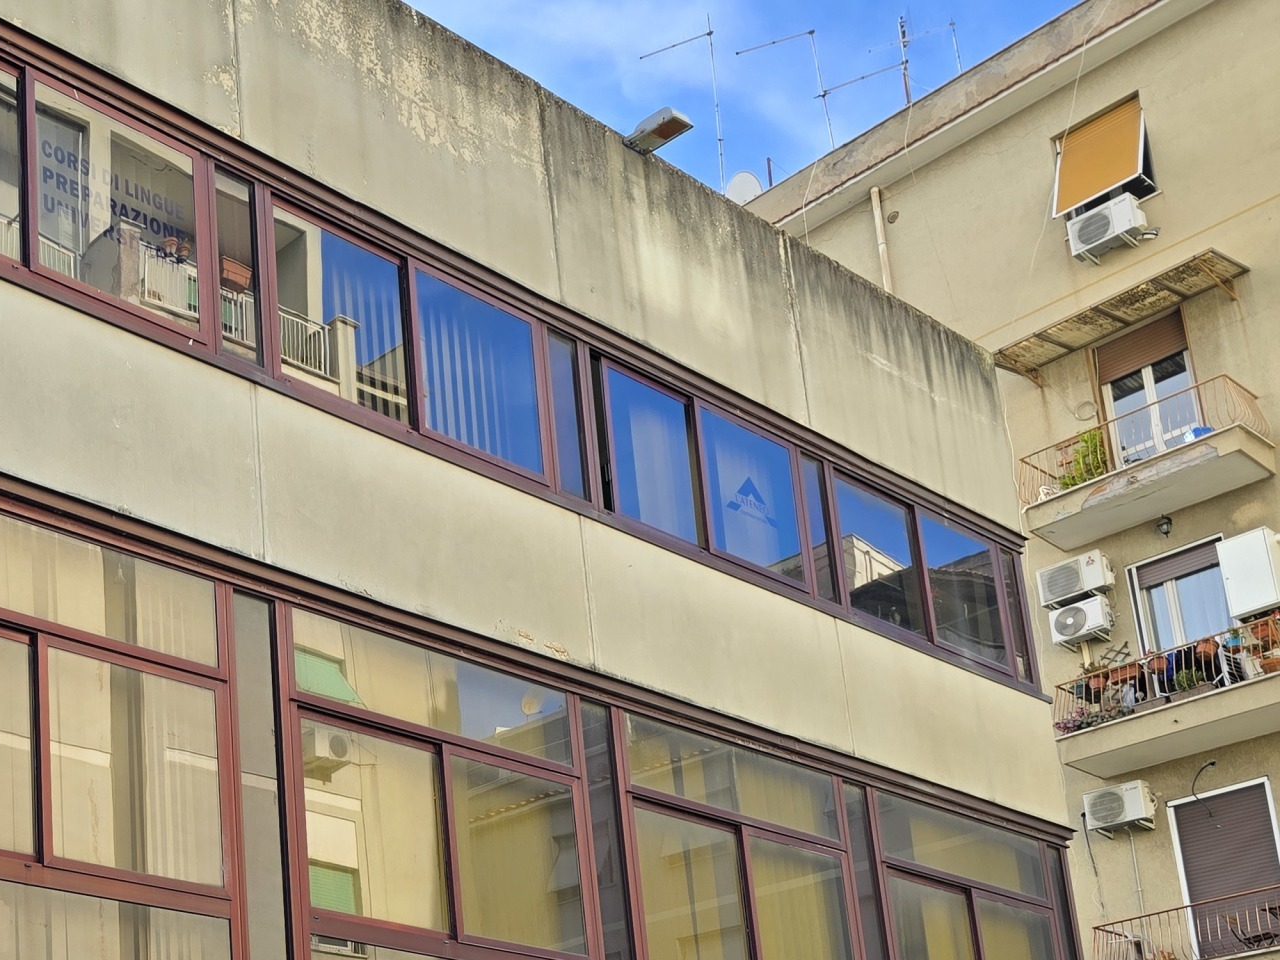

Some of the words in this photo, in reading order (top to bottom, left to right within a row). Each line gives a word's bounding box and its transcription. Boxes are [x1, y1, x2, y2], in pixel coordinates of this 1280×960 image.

[41, 139, 96, 180] CORSI
[103, 168, 119, 190] DI
[125, 178, 185, 221] LINGUE
[42, 165, 186, 242] PREPARAZIONE
